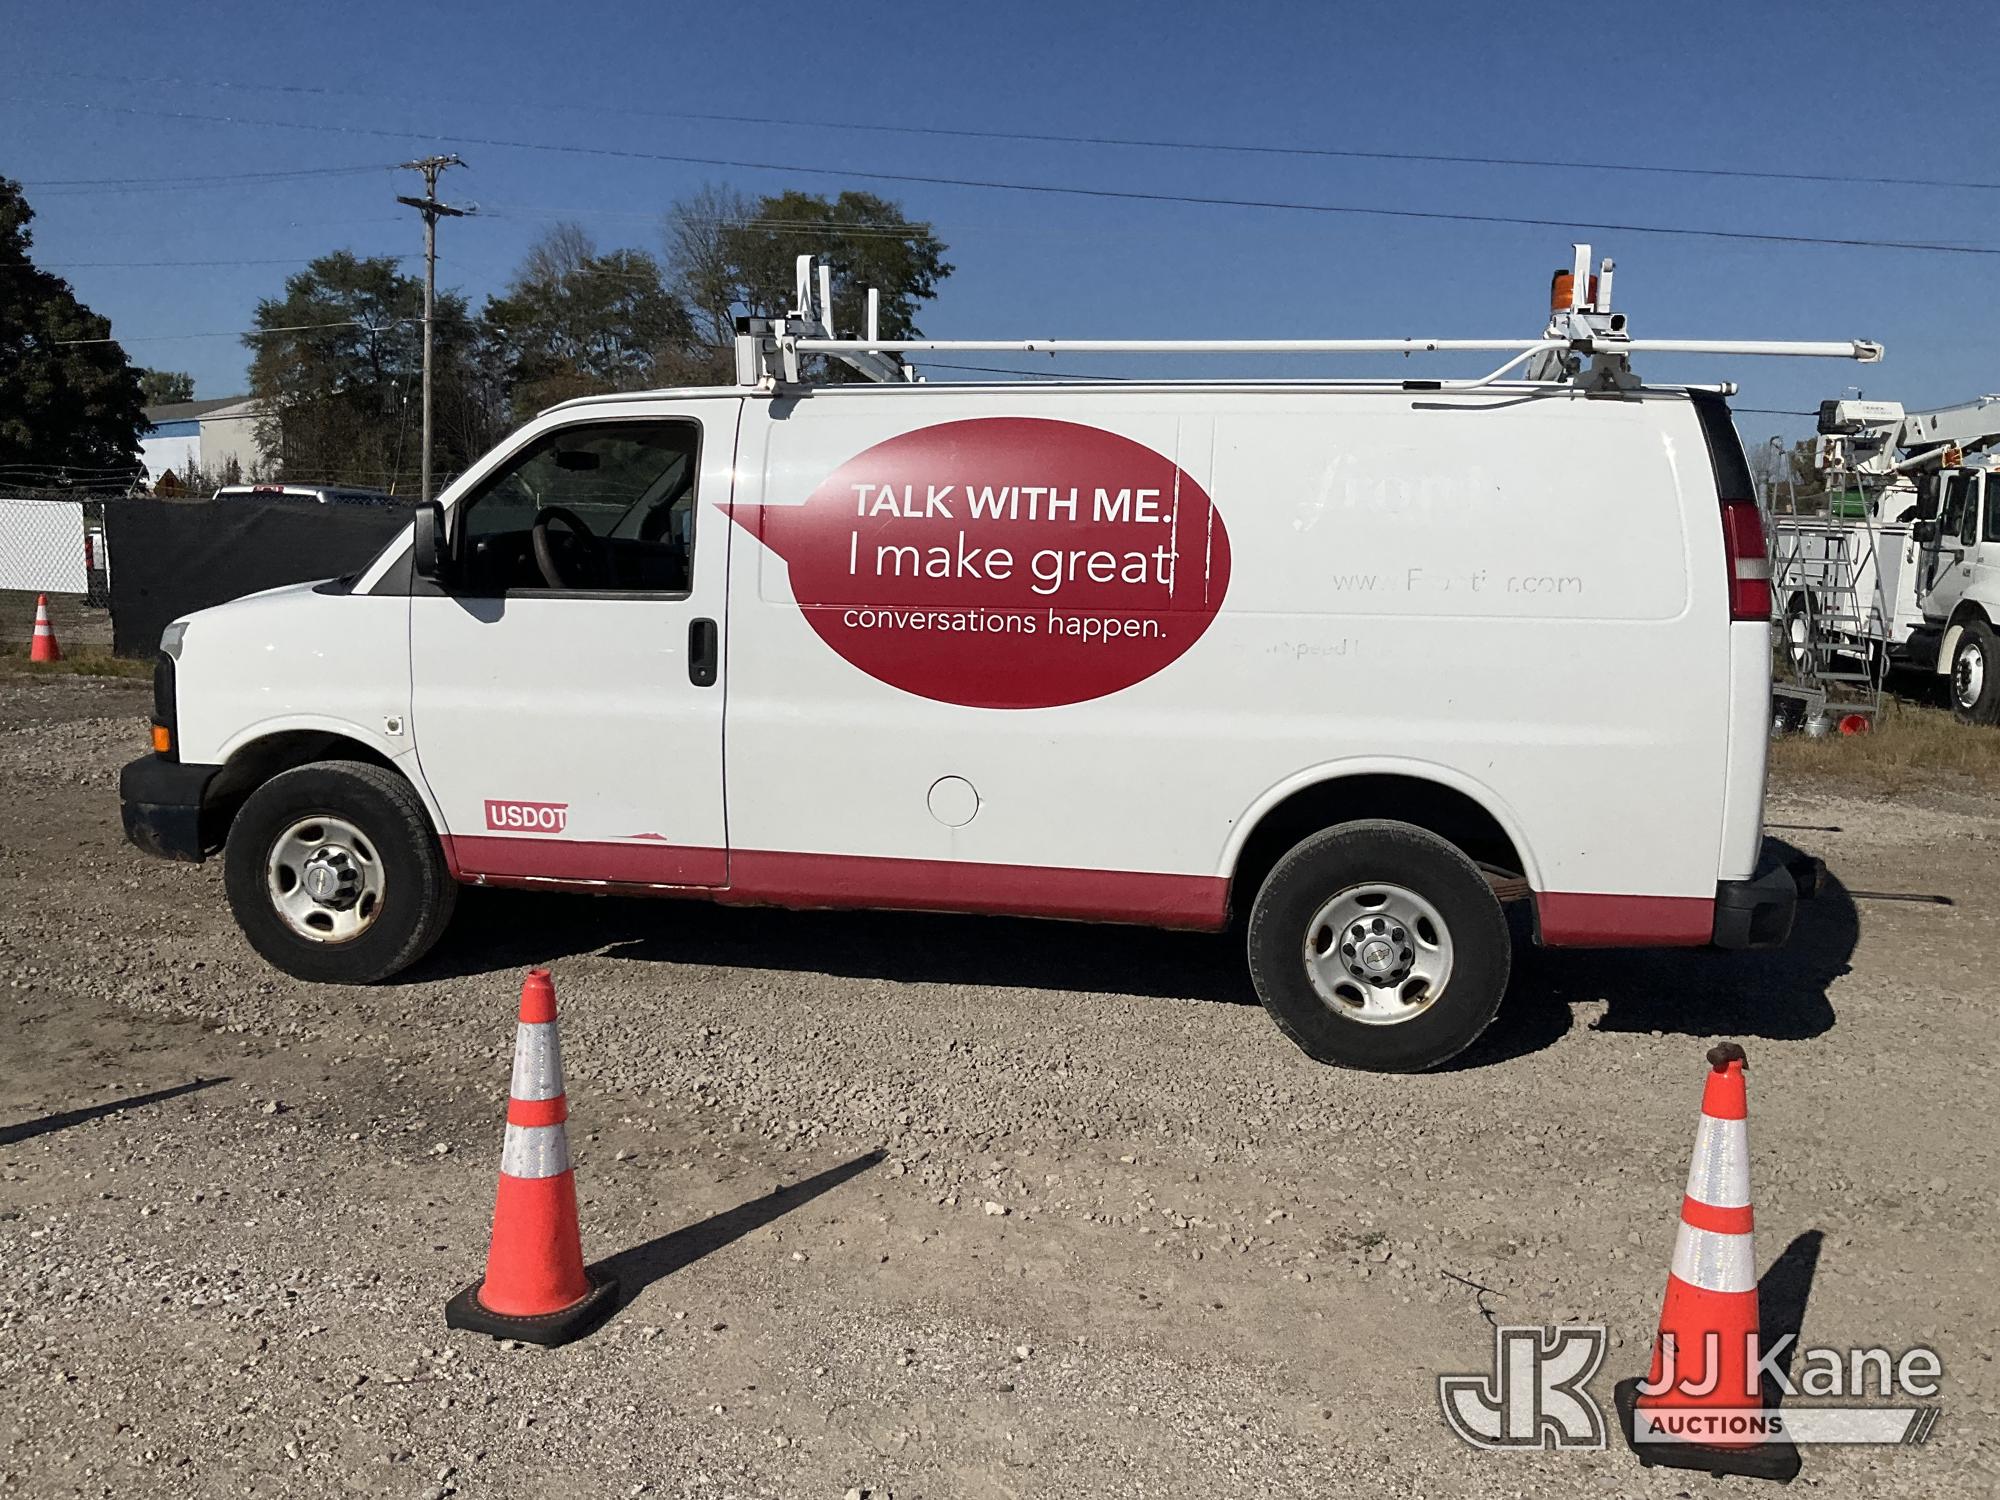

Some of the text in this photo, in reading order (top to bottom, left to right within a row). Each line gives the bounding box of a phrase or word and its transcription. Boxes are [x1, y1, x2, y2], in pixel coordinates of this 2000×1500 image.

[851, 484, 1172, 524] TALK WITH ME.
[849, 530, 1179, 595] I make great
[844, 607, 1167, 643] conversations happen.
[491, 805, 567, 829] USDOT
